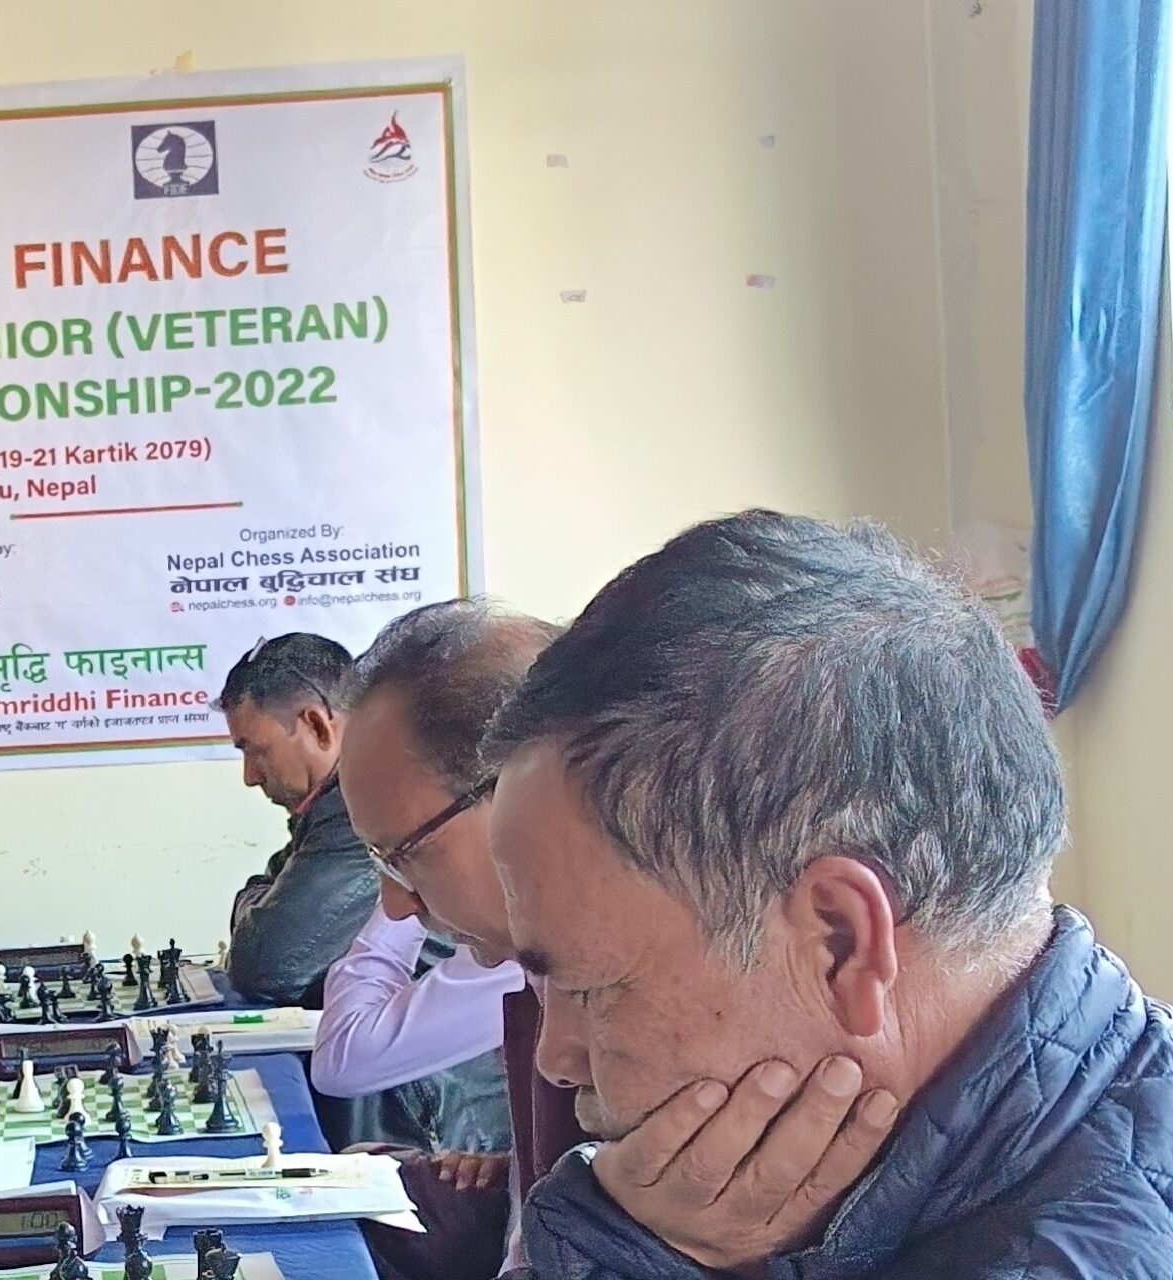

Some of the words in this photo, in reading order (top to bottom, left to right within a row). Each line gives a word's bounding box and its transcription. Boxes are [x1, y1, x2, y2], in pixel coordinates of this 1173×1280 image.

[14, 227, 289, 289] FINANCE
[107, 295, 389, 359] (VETERAN)
[65, 441, 137, 465] Kartik
[146, 437, 212, 461] 2079)
[27, 474, 97, 501] Nepal
[239, 526, 317, 544] Organized
[321, 524, 344, 539] By:
[167, 552, 224, 573] Nepal
[231, 549, 295, 568] Chess
[300, 542, 421, 564] Association
[170, 575, 249, 594] नेपाल
[375, 565, 421, 584] संघ
[189, 595, 277, 612] nepalchess.org
[297, 589, 422, 608] info@nepalchess.org
[63, 644, 207, 680] फाइनान्स
[106, 689, 209, 710] Finance
